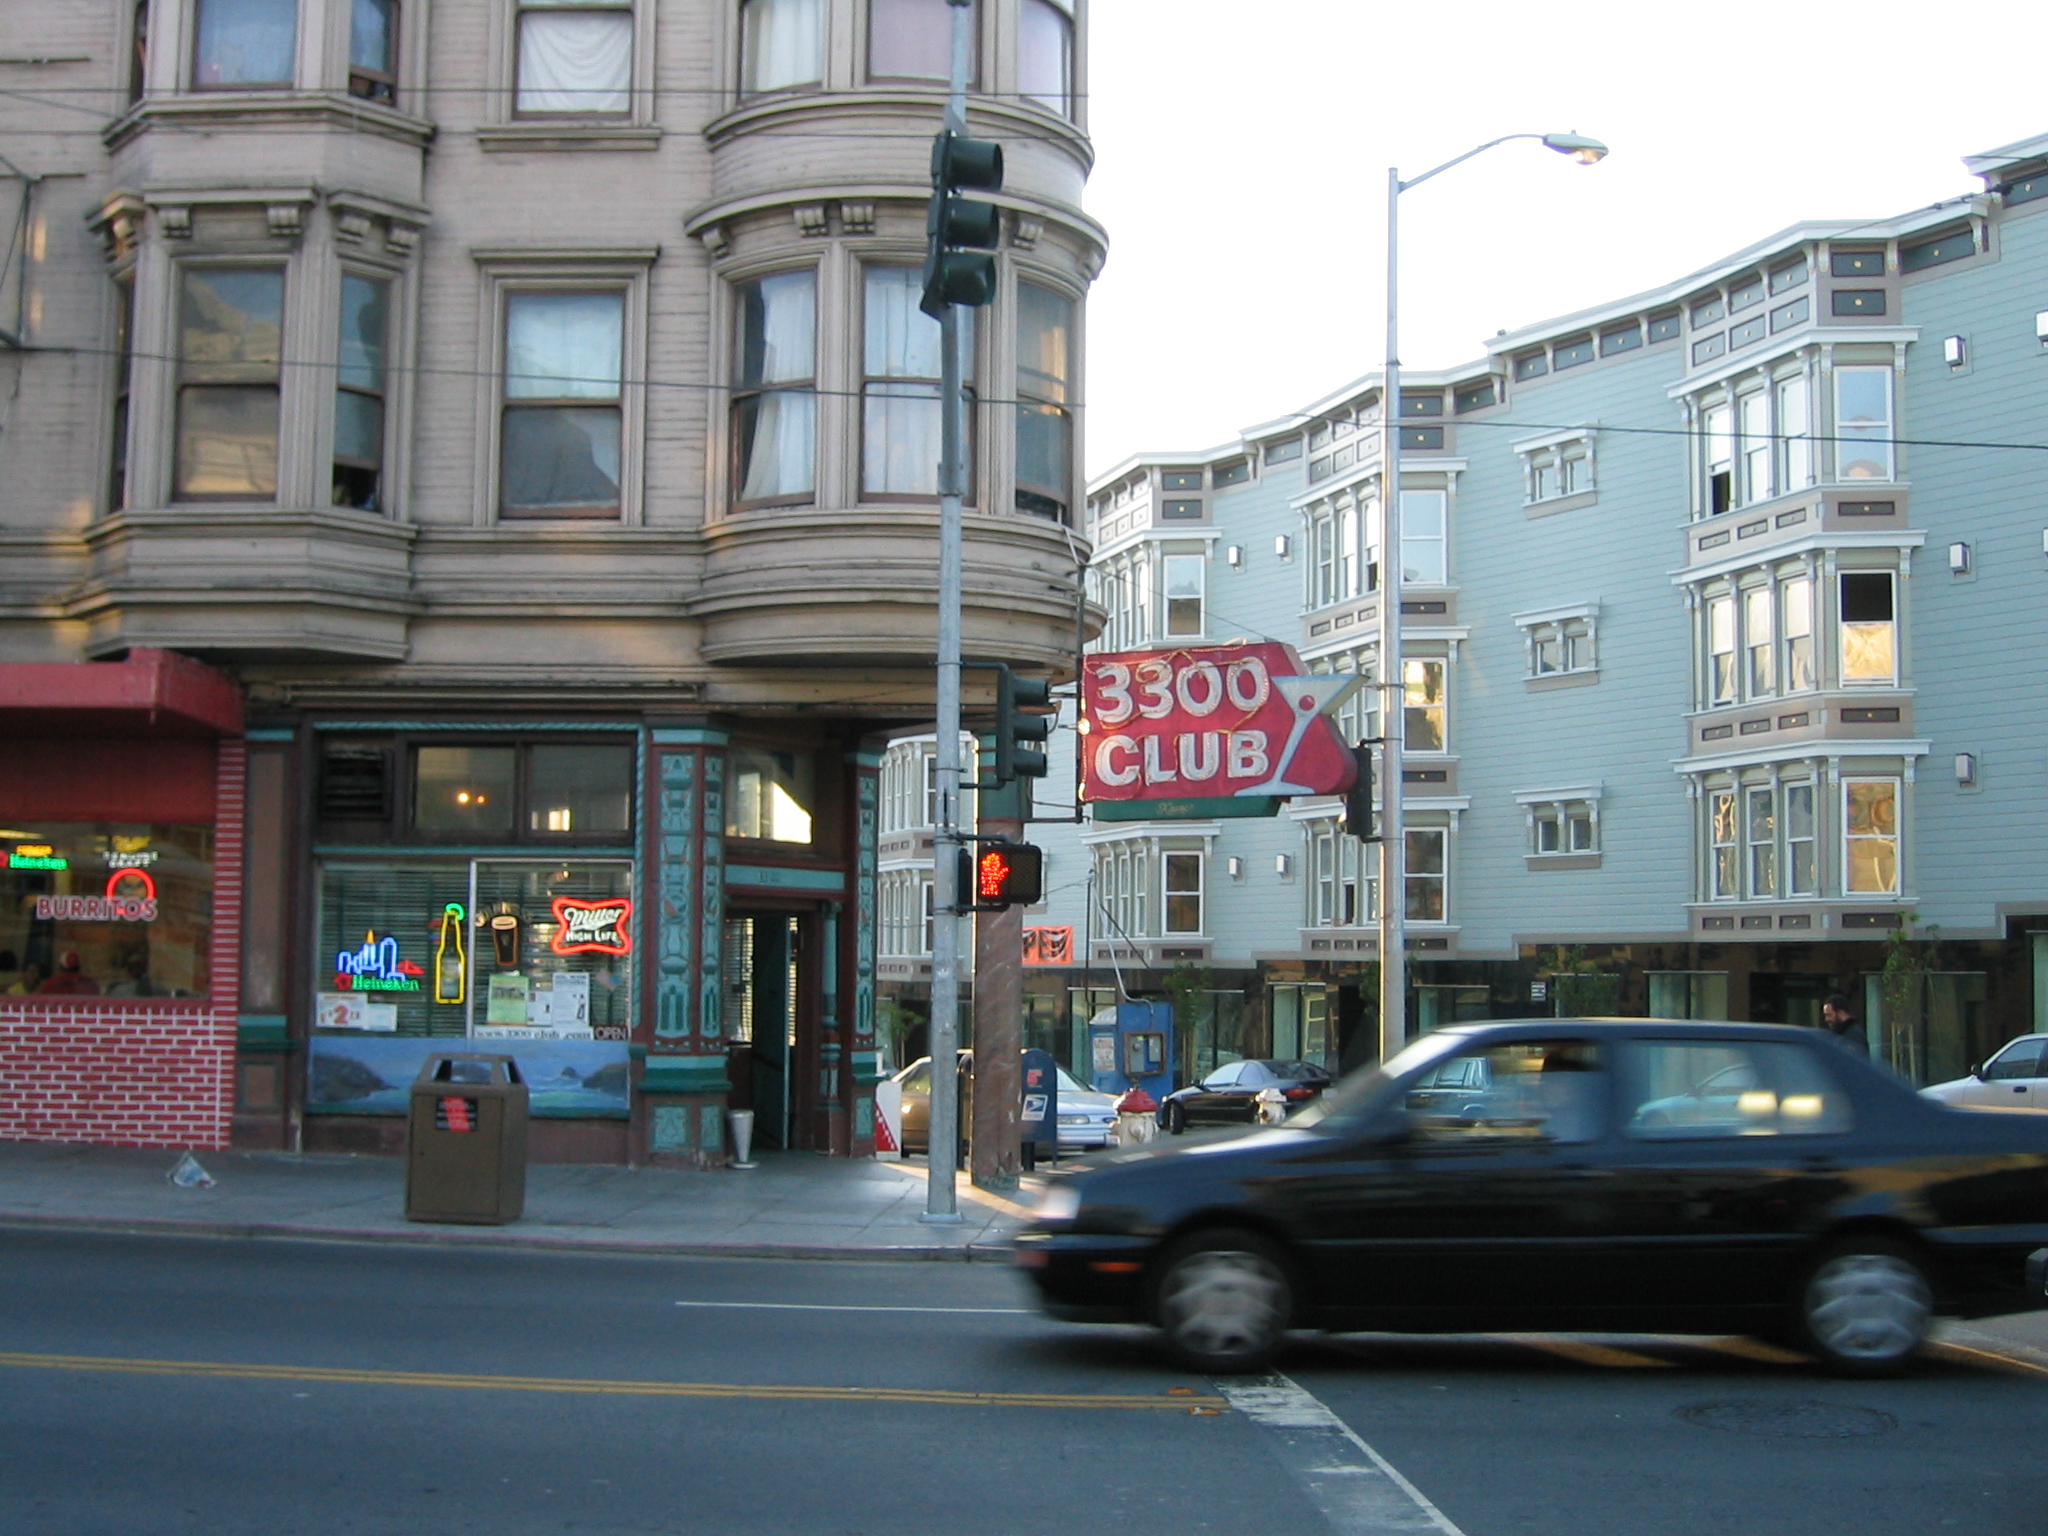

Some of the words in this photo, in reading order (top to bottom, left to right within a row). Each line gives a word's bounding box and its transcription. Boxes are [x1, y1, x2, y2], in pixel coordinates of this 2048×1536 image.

[1094, 656, 1271, 724] 3300
[1095, 730, 1269, 787] CLUB
[36, 895, 159, 922] BURRITOS
[563, 907, 624, 931] Miller
[565, 930, 592, 942] HIGH
[352, 974, 421, 991] Heineken
[595, 1027, 628, 1040] OPEN
